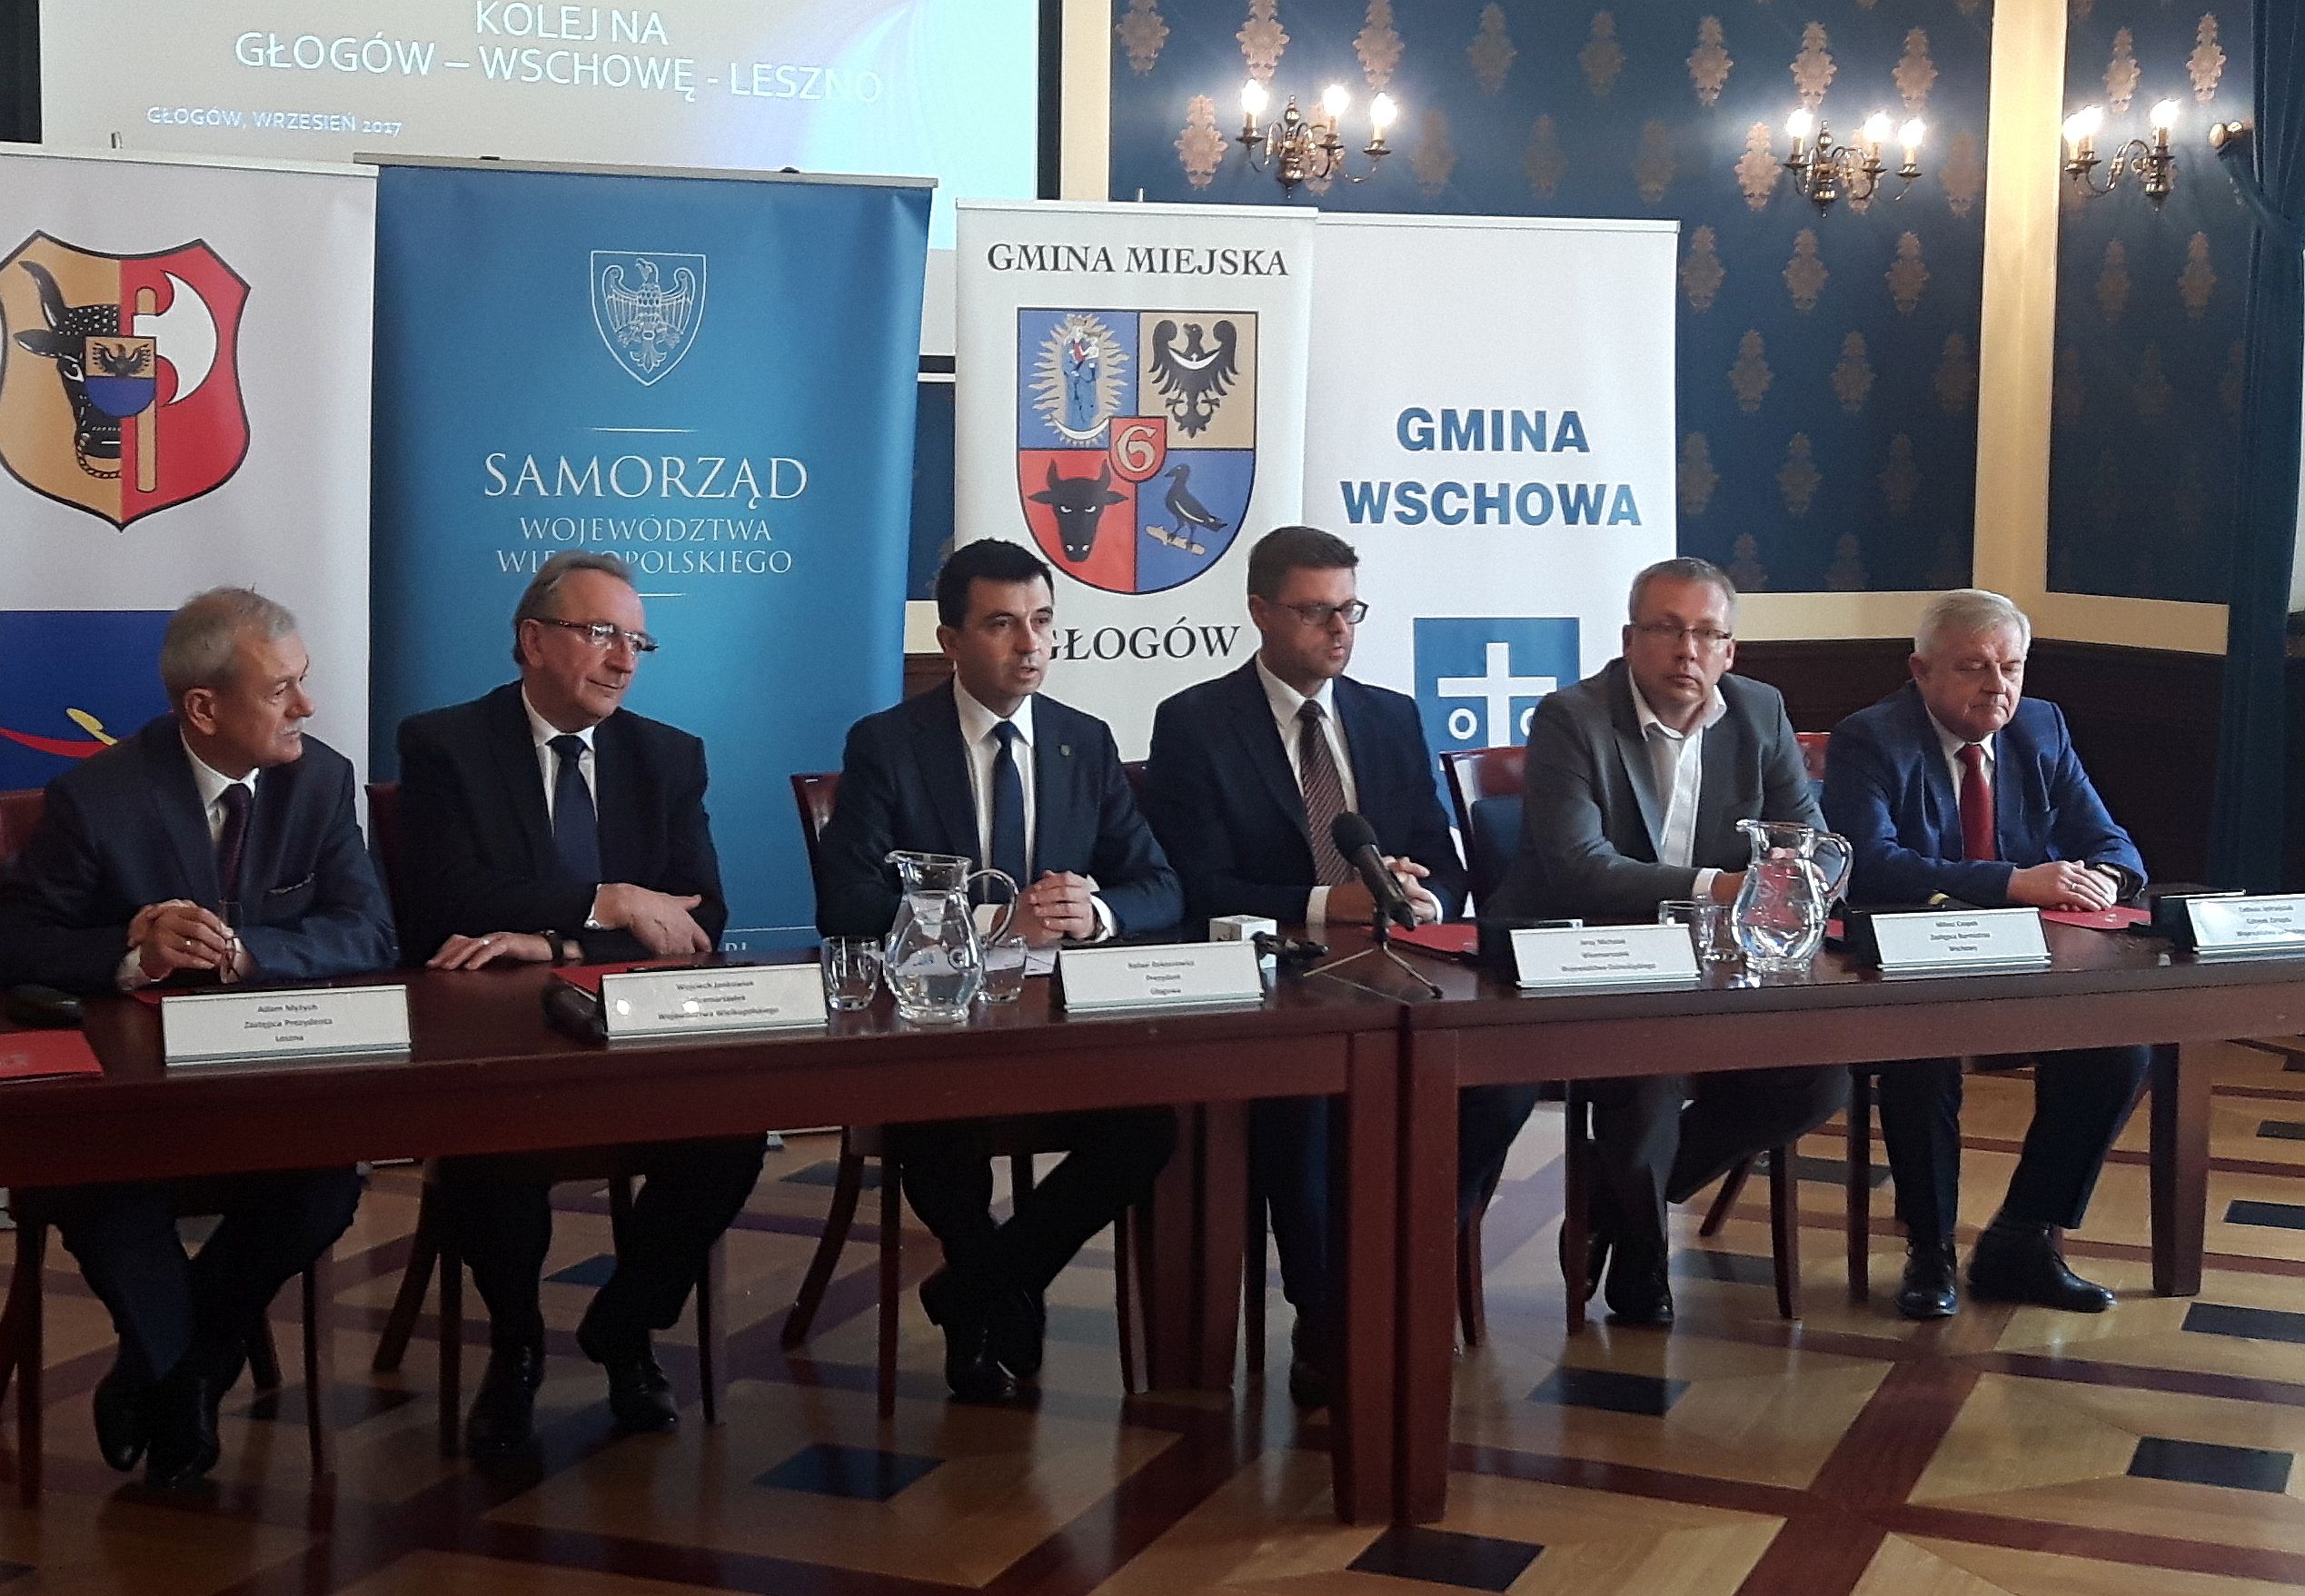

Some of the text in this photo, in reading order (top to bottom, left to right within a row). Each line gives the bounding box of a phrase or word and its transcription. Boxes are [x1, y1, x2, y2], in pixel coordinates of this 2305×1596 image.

[476, 0, 669, 45] KOLEJ NA
[234, 30, 435, 75] GŁOGÓW
[478, 45, 696, 103] WSCHOWĘ
[730, 62, 882, 103] LESZNO
[146, 104, 402, 137] GŁOGÓW, WRZESIEŃ 2017
[987, 243, 1290, 276] GMINA MIEJSKA
[1396, 406, 1591, 453] GMINA
[483, 451, 809, 510] SAMORZĄD
[1339, 480, 1643, 527] WSCHOWA
[519, 513, 772, 546] WOJEWÓDZTWA
